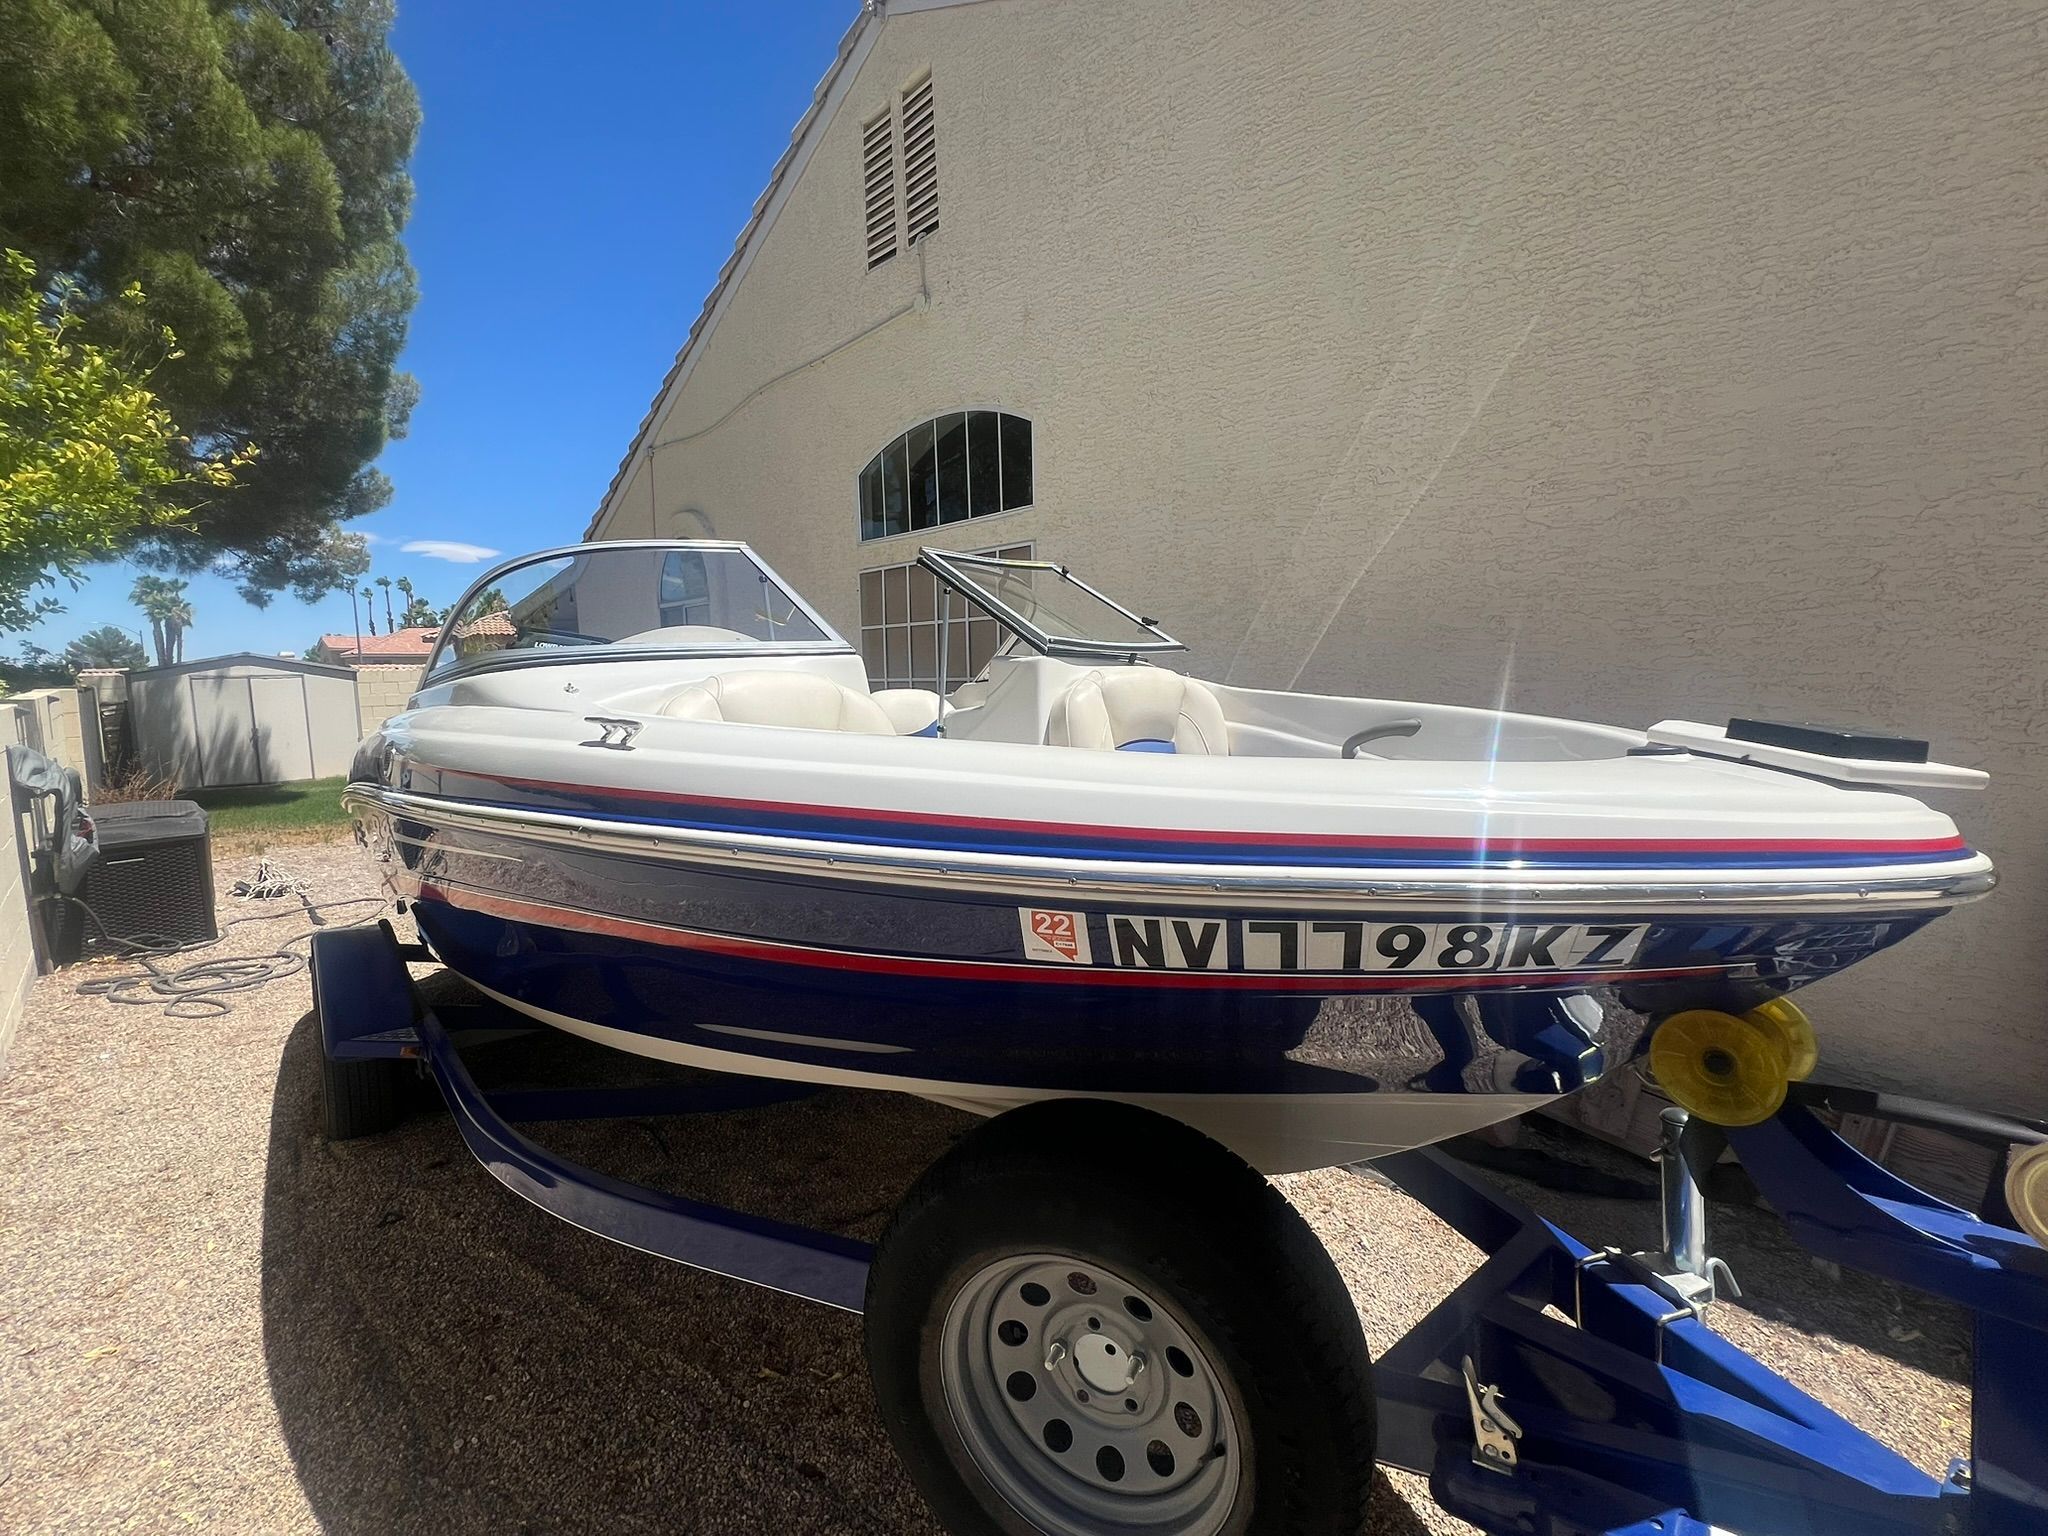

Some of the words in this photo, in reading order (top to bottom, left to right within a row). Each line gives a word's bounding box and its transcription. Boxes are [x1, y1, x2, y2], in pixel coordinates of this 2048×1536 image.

[1035, 912, 1072, 936] 22
[1113, 918, 1221, 969] NV
[1248, 921, 1494, 970] 7798
[1507, 925, 1642, 967] KZ
